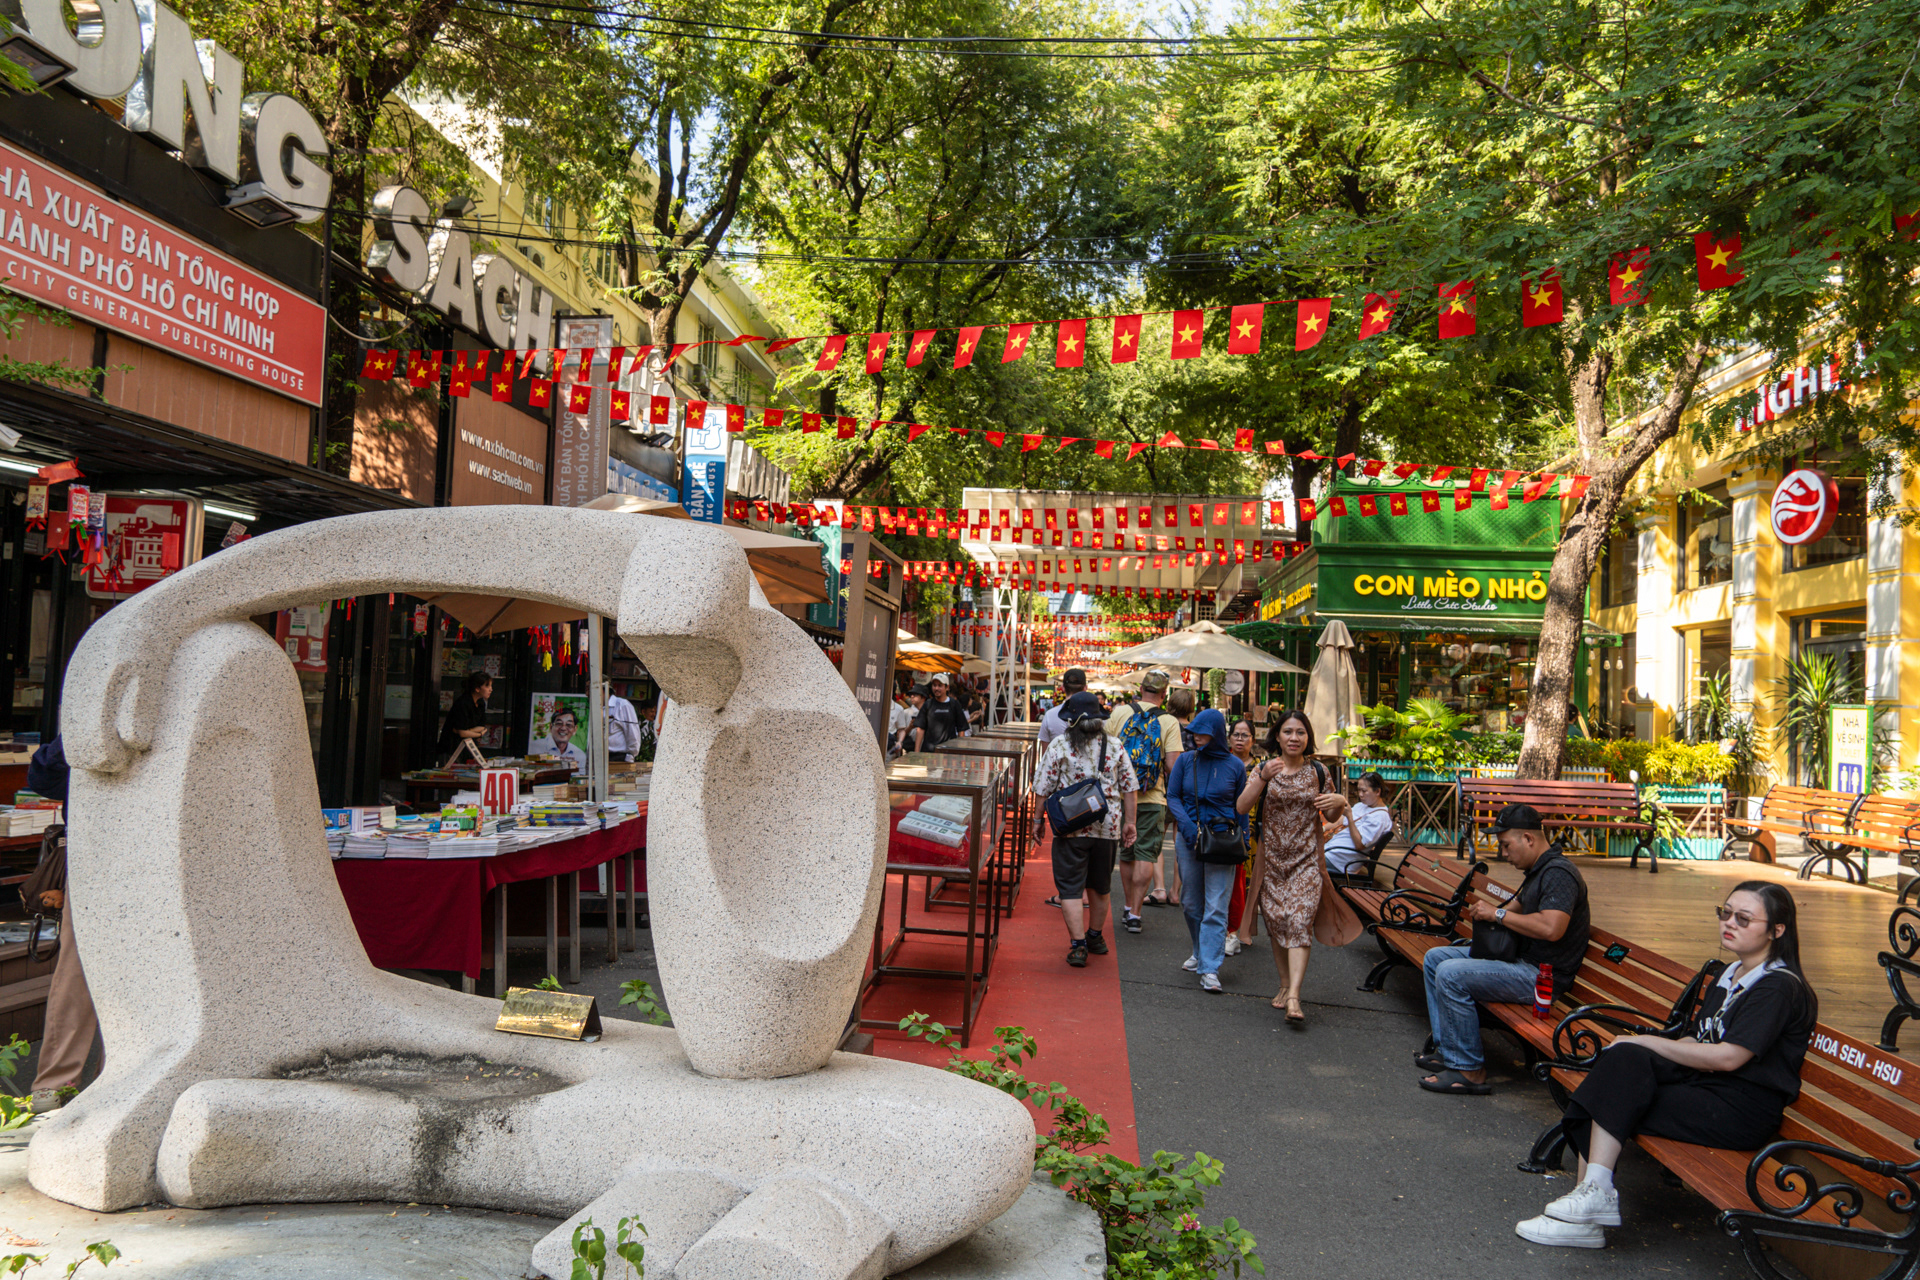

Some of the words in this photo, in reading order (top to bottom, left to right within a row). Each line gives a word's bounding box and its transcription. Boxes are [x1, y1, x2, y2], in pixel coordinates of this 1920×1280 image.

[43, 185, 115, 243] XUẤT
[121, 224, 171, 272] BẢN
[176, 250, 235, 301] TỔNG
[240, 282, 280, 320] HỢP
[79, 245, 134, 292] PHỐ
[141, 272, 176, 310] HỒ
[182, 293, 219, 330] CHÍ
[223, 310, 275, 354] MINH
[7, 260, 55, 291] CITY
[67, 285, 151, 330] GENERAL
[161, 322, 254, 371] PUBLISHING
[261, 363, 304, 391] HOUSE
[461, 428, 544, 475] www.nxbhcm.com.vn
[557, 448, 573, 474] BẢN
[469, 459, 532, 495] www.sachweb.vn
[574, 464, 588, 491] PHỐ
[687, 462, 707, 488] TRẺ
[707, 462, 716, 493] HOUSE
[685, 490, 705, 517] BẢN
[1354, 574, 1415, 596] CON
[1423, 569, 1481, 598] MÈO
[1488, 571, 1548, 601] NHỎ
[1401, 595, 1433, 611] Little
[1461, 597, 1498, 611] Studio
[1842, 715, 1860, 728] NHÀ
[1847, 733, 1866, 745] SINH
[484, 772, 514, 815] 40
[1814, 1033, 1839, 1057] HOA
[1839, 1044, 1866, 1069] SEN
[1872, 1059, 1902, 1086] HSU
